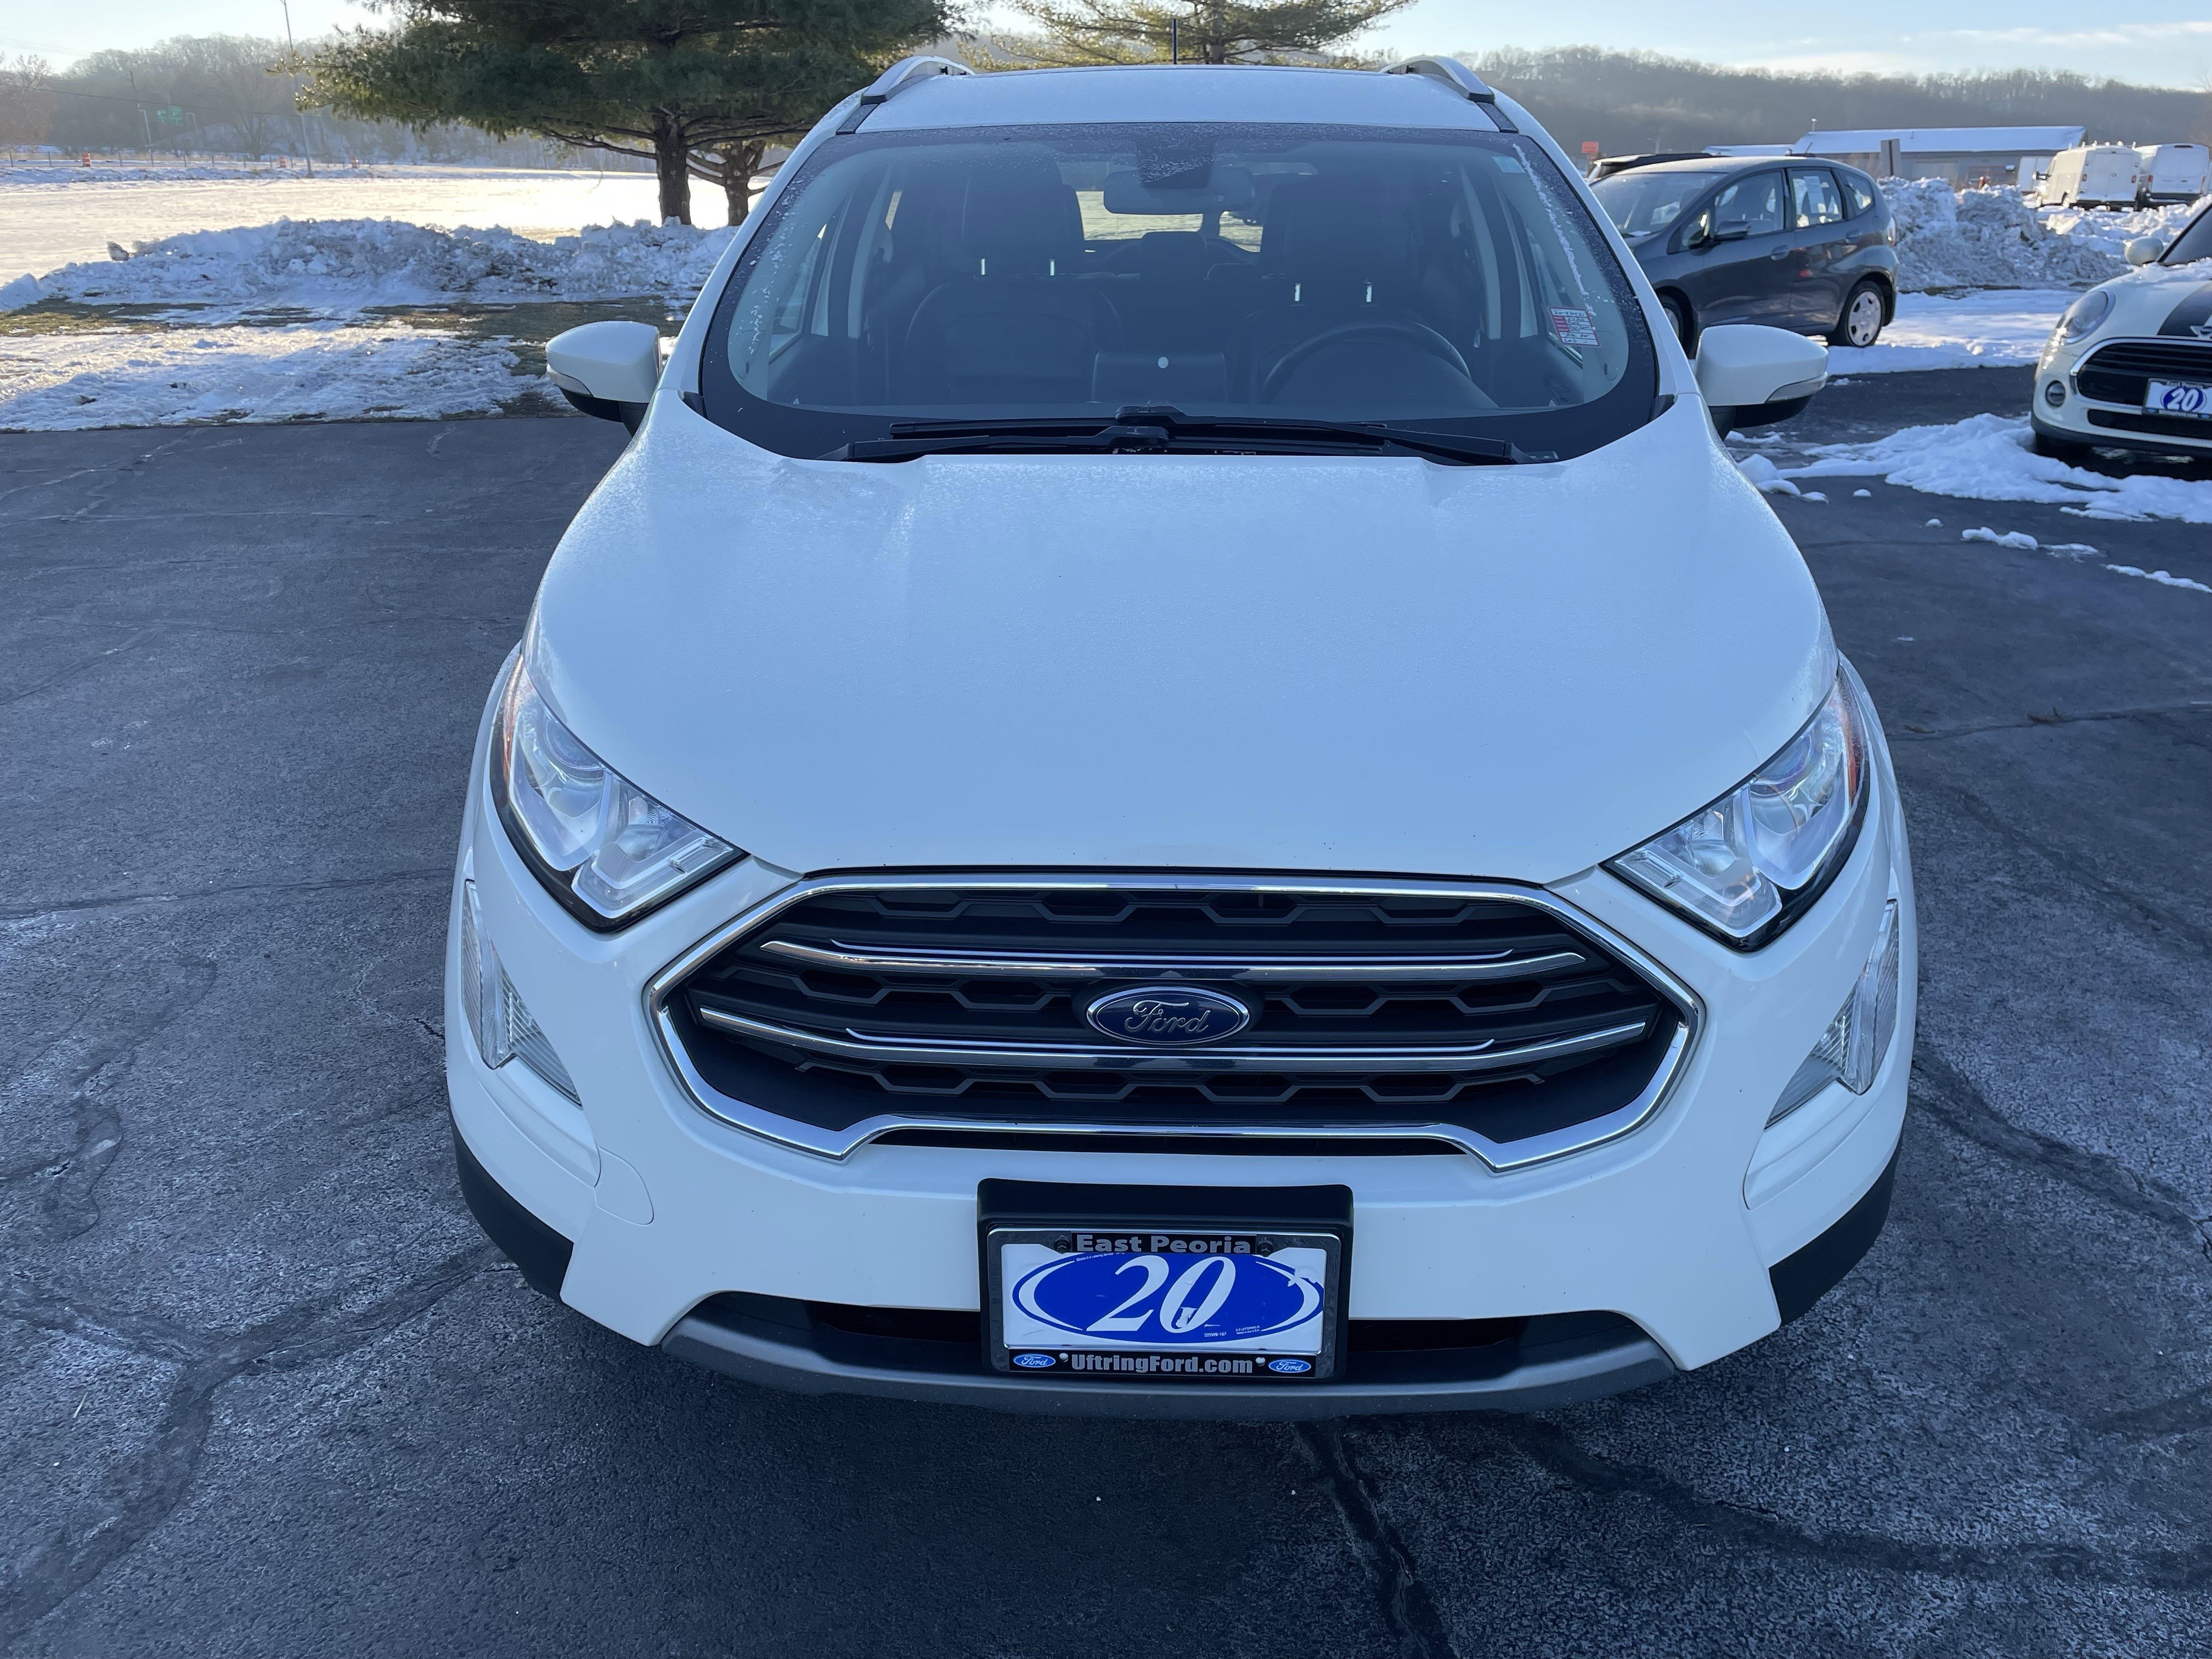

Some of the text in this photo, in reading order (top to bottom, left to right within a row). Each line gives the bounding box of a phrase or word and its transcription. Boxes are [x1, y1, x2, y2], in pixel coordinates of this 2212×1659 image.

[2167, 387, 2199, 411] 20
[1125, 1000, 1211, 1034] Ford
[1077, 1234, 1250, 1254] East Peoria
[1086, 1255, 1235, 1333] 20
[1021, 1356, 1048, 1365] Ford
[1071, 1354, 1252, 1373] UftringFord.com
[1276, 1361, 1303, 1371] Ford
